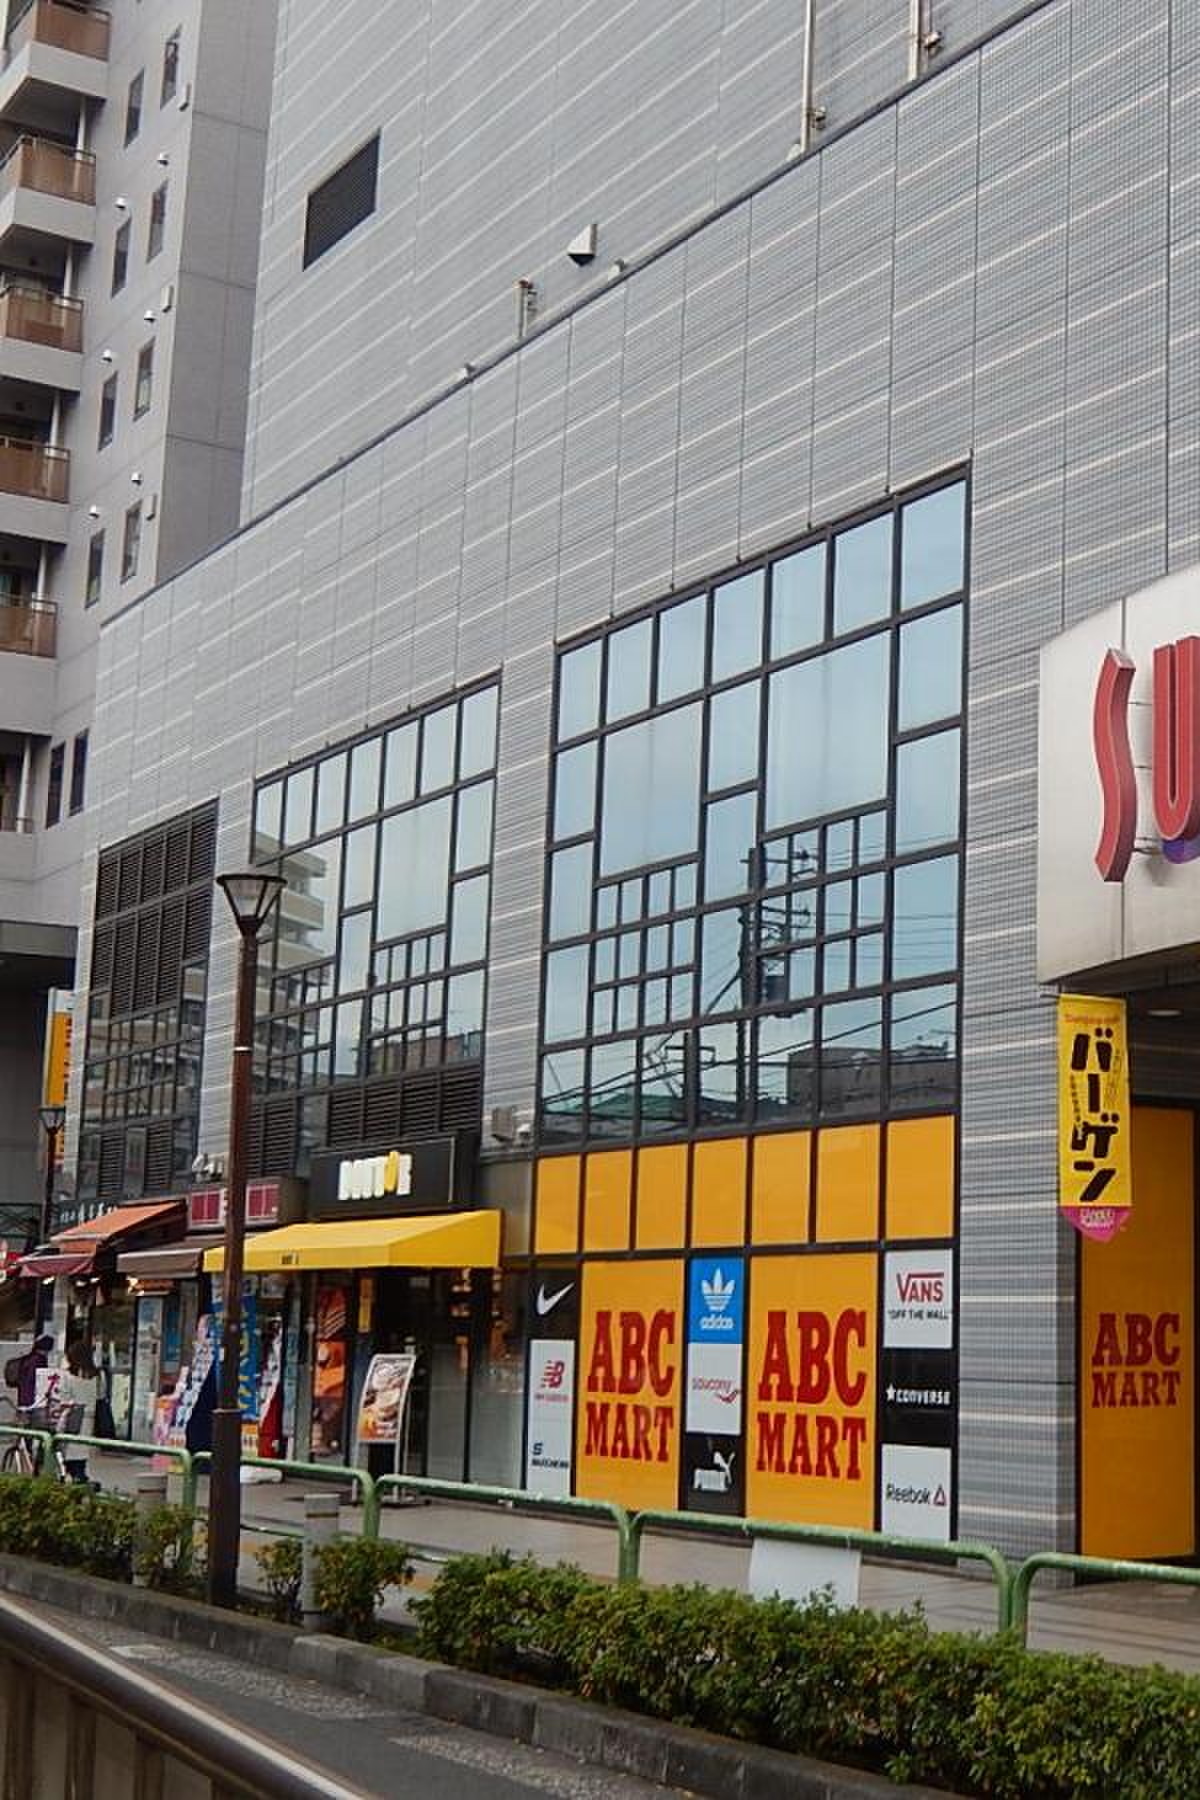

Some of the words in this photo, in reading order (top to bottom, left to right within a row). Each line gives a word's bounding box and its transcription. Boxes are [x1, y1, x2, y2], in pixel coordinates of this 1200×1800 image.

[1070, 1027, 1120, 1202] バーゲン
[896, 1272, 944, 1303] VANS
[587, 1309, 676, 1397] ABC
[758, 1308, 867, 1407] ABC
[1092, 1312, 1181, 1367] ABC
[1092, 1371, 1181, 1408] MART
[585, 1402, 674, 1463] MART
[756, 1412, 866, 1480] MART
